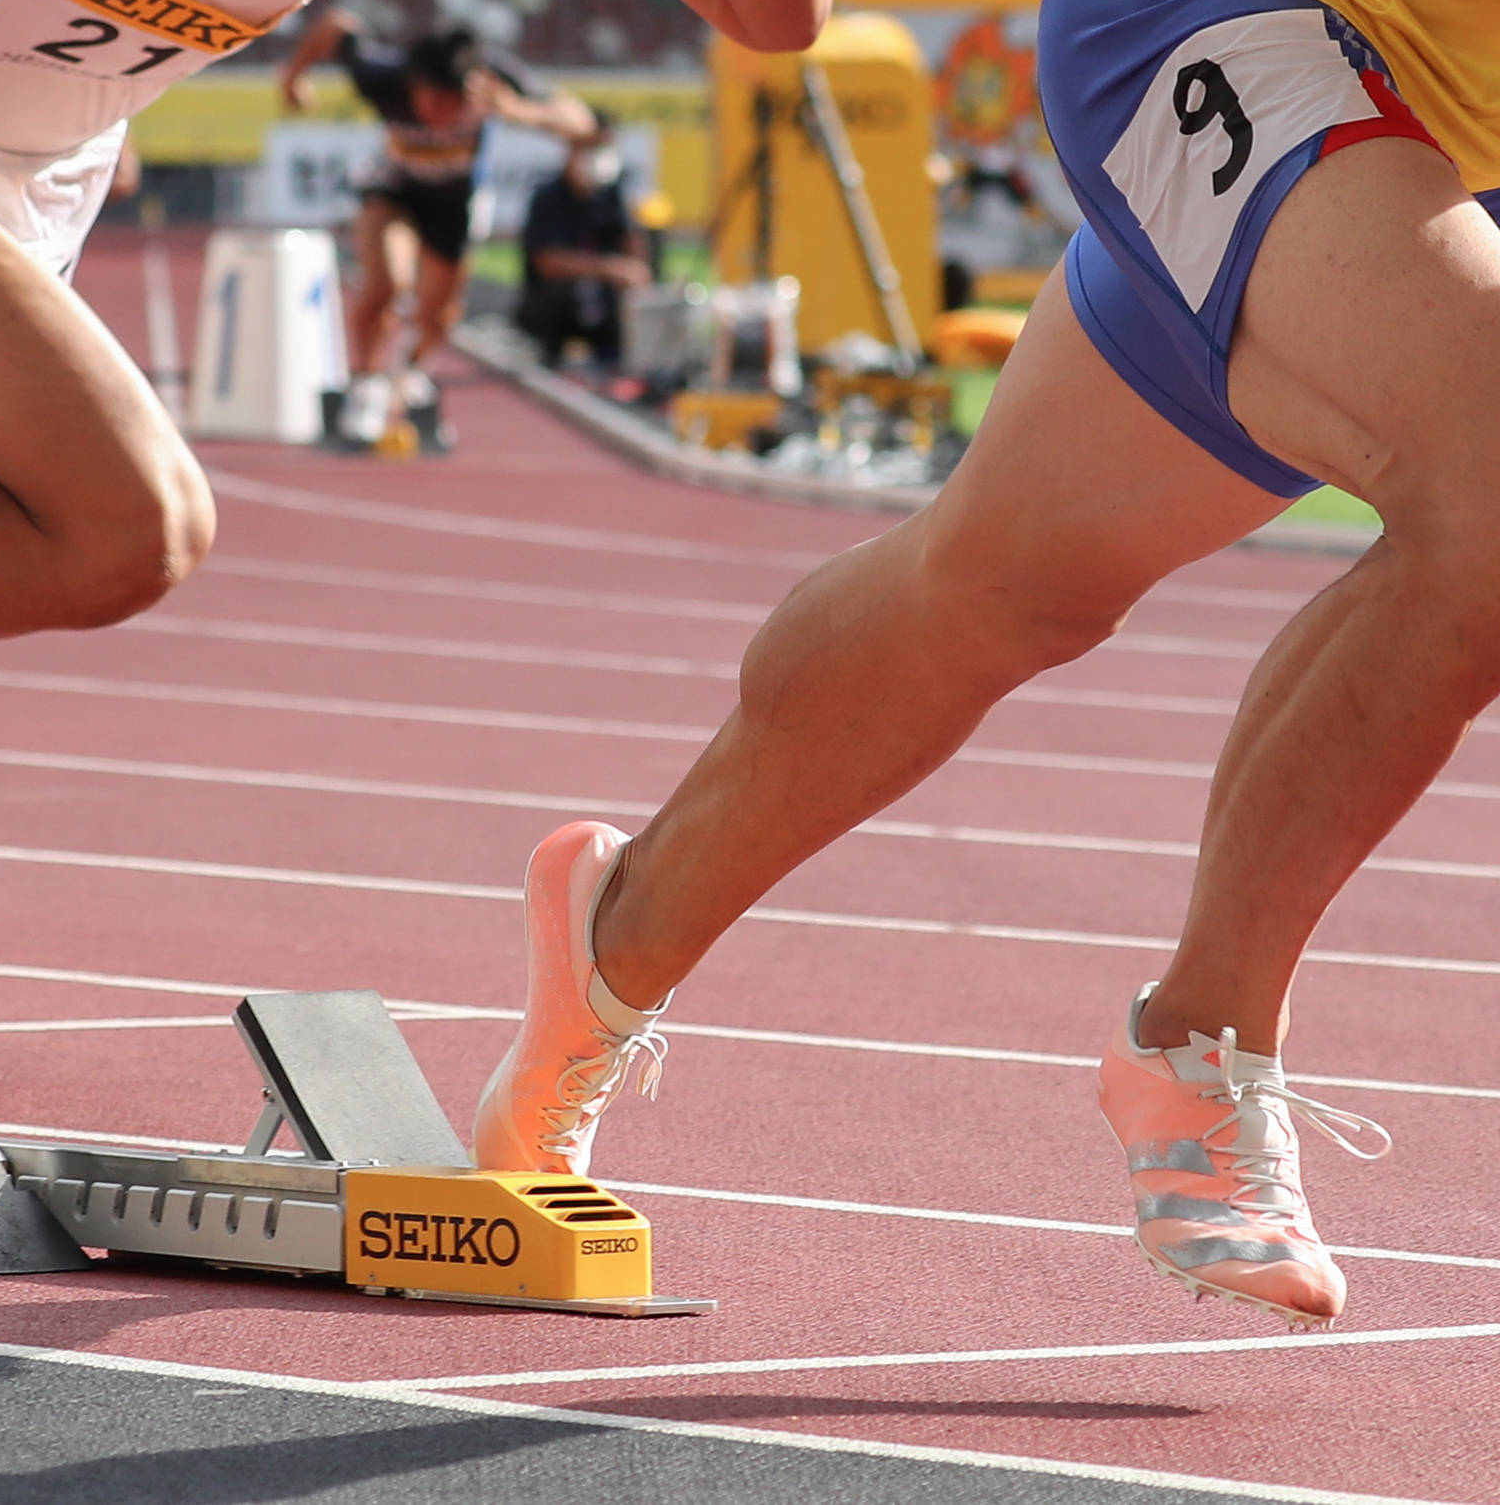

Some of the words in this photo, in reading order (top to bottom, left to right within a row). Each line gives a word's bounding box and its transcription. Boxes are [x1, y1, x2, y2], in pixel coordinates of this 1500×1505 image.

[32, 17, 186, 76] 21
[1173, 57, 1254, 198] 9
[359, 1210, 521, 1268] SEIKO
[581, 1237, 639, 1256] SEIKO
